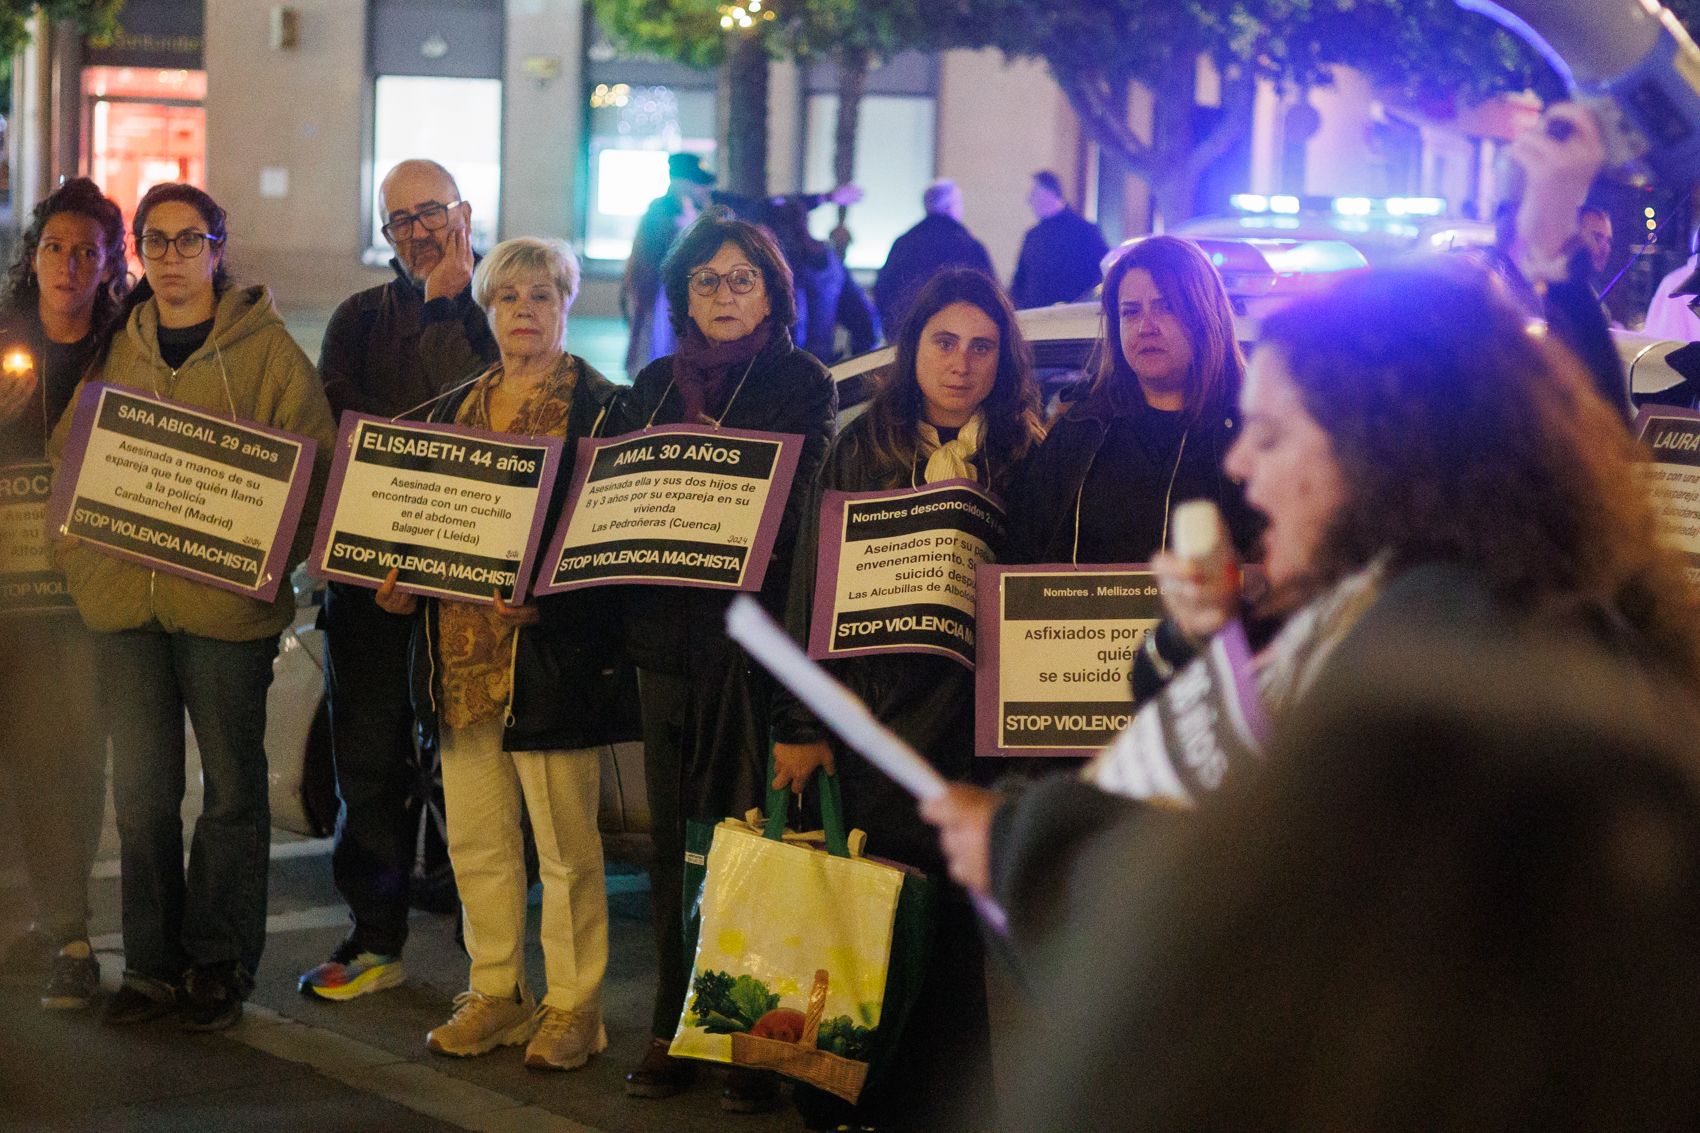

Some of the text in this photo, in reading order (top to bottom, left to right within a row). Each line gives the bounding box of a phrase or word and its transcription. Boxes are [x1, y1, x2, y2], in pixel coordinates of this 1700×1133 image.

[117, 404, 279, 463] SARA ABIGAIL 29 años
[1653, 431, 1700, 451] LAURA
[362, 432, 535, 474] ELISABETH 44 años
[613, 443, 741, 467] AMAL 30 AÑOS
[118, 440, 261, 491] Asesinada a manos de su
[105, 453, 264, 508] expareja que fue quién llamó
[146, 481, 153, 490] a
[156, 481, 165, 494] la
[390, 476, 502, 505] Asesinada en enero y
[589, 475, 756, 496] Asesinada ella y sus dos hijos de
[114, 486, 233, 532] Carabanchel (Madrid)
[371, 489, 512, 520] encontrada con un cuchillo
[592, 499, 599, 509] y
[600, 495, 606, 506] 3
[607, 493, 629, 505] años
[630, 492, 647, 503] por
[650, 490, 663, 499] su
[665, 489, 714, 503] expareja
[717, 494, 732, 505] en
[735, 496, 750, 506] su
[633, 503, 676, 513] vivienda
[401, 510, 476, 529] en el abdomen
[852, 509, 908, 523] Nombres
[911, 501, 985, 521] desconocidos
[391, 521, 435, 538] Balaguer
[591, 517, 721, 532] Las Pedroñeras (Cuenca)
[73, 508, 259, 574] STOP VIOLENCIA MACHISTA
[864, 536, 972, 555] Aseinados por su
[333, 543, 516, 586] STOP VIOLENCIA MACHISTA
[559, 550, 741, 572] STOP VIOLENCIA MACHISTA
[856, 552, 965, 571] envenenamiento.
[895, 567, 944, 581] suicidó
[848, 590, 867, 600] Las
[871, 583, 923, 597] Alcubillas
[927, 583, 941, 592] de
[1044, 588, 1088, 597] Nombres
[1097, 586, 1141, 596] Mellizos
[1144, 586, 1158, 596] de
[838, 621, 883, 637] STOP
[885, 616, 964, 637] VIOLENCIA
[1025, 627, 1106, 640] Asfixiados
[1111, 628, 1138, 642] por
[1039, 671, 1058, 682] se
[1063, 667, 1121, 682] suicidó
[1006, 715, 1051, 730] STOP
